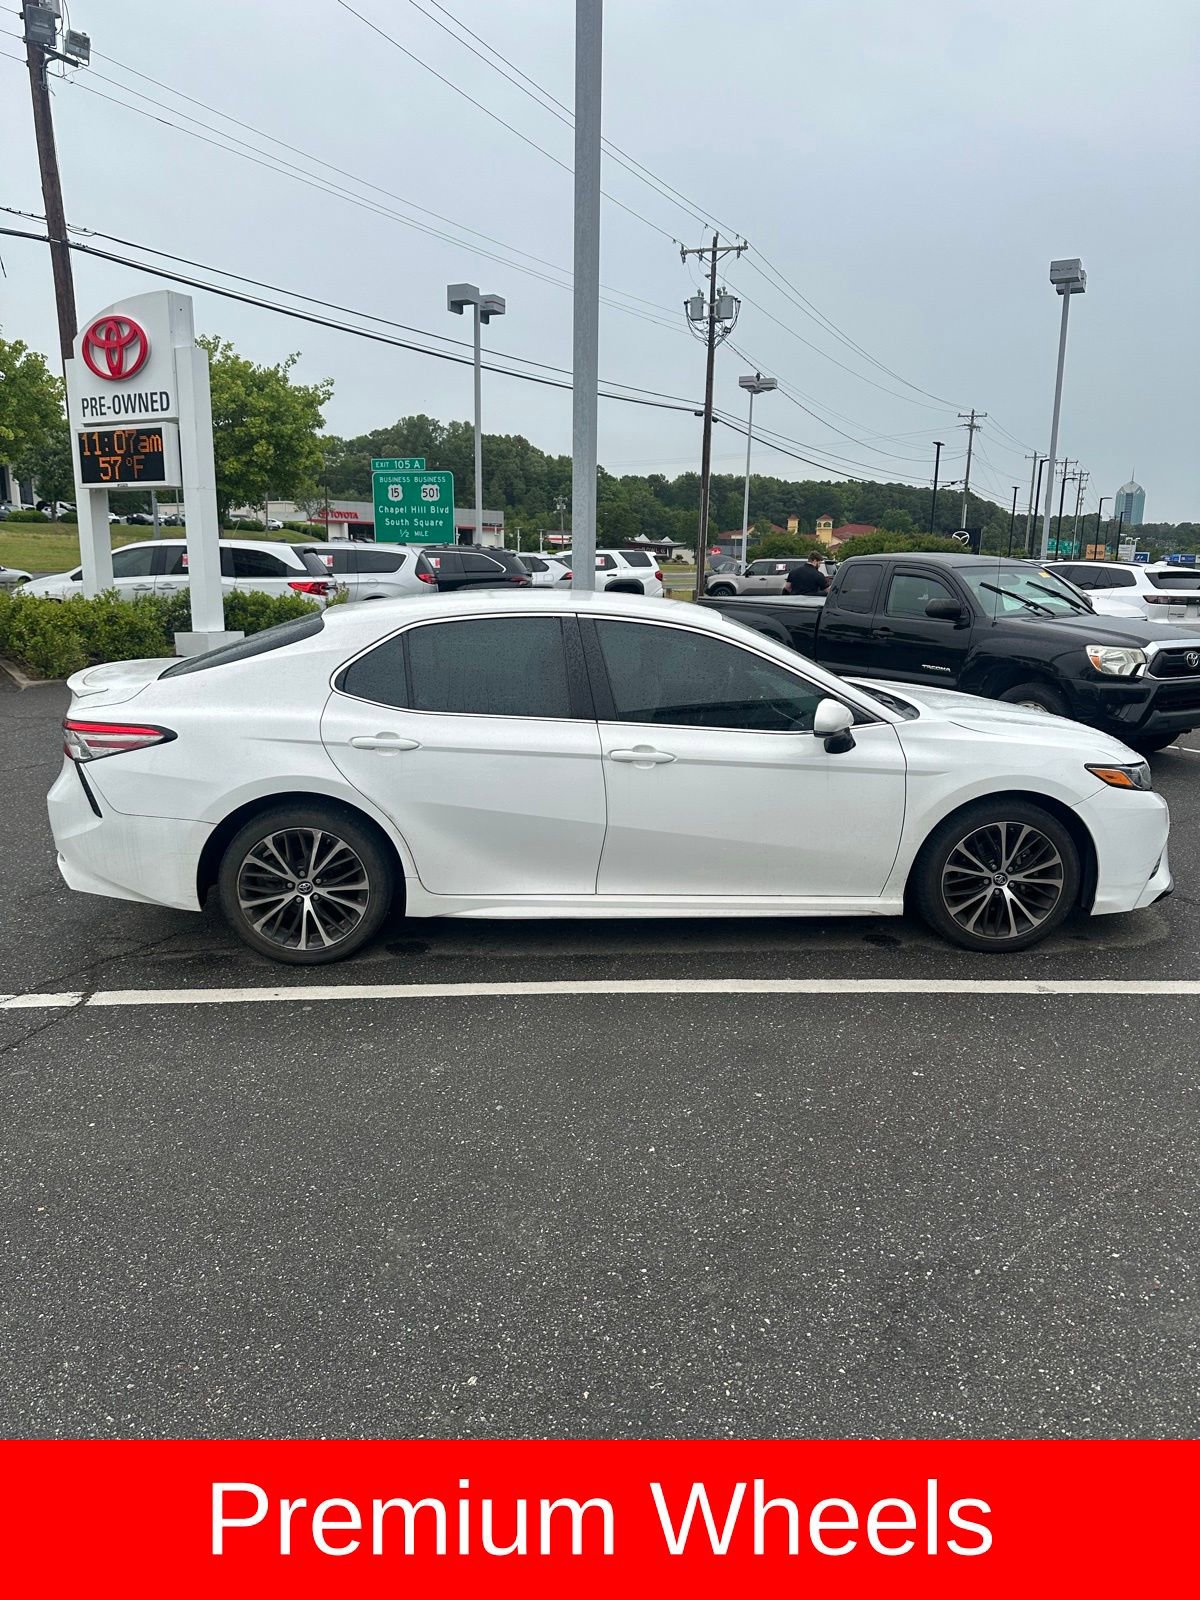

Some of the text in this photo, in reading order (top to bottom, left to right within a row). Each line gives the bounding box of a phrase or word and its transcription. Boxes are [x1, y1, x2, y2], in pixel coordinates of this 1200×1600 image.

[81, 391, 170, 417] PRE-OWNED
[394, 460, 411, 469] 105
[413, 460, 421, 469] A
[391, 487, 400, 498] 15
[422, 487, 439, 498] 501
[378, 505, 407, 514] Chapel
[430, 505, 449, 513] Blvd
[330, 511, 359, 519] TOYOTA
[384, 518, 444, 527] South Square
